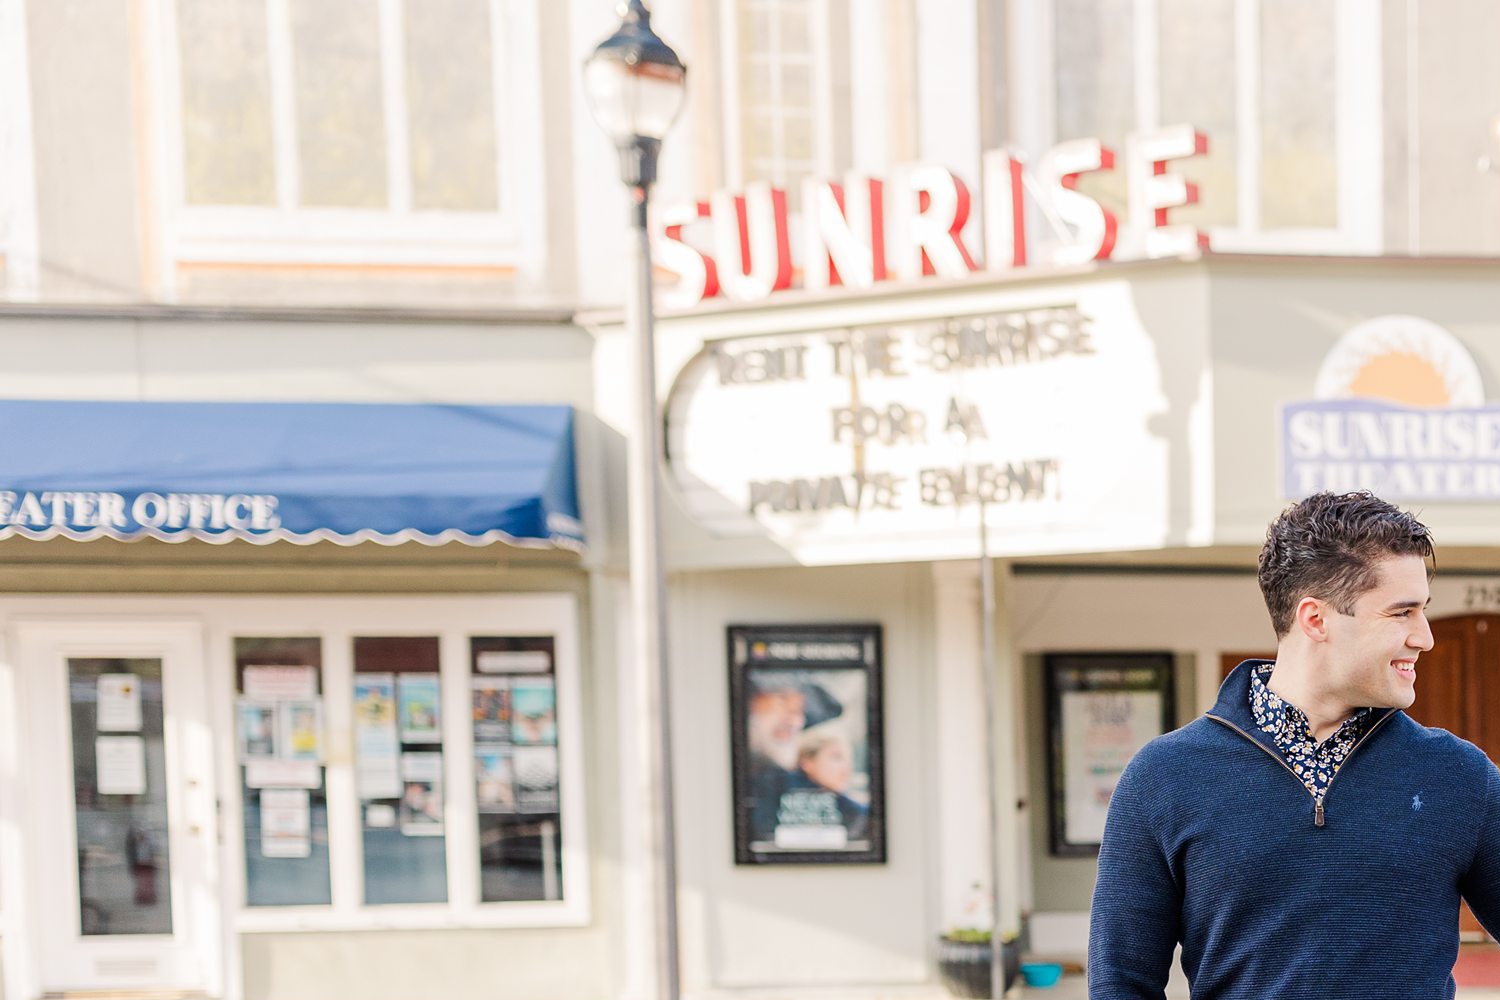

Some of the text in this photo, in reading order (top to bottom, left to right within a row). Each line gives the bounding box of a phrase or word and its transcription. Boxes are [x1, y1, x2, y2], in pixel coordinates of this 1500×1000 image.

[650, 124, 1209, 308] SUNRISE
[831, 403, 926, 446] FOR
[0, 491, 281, 530] EATER OFFICE
